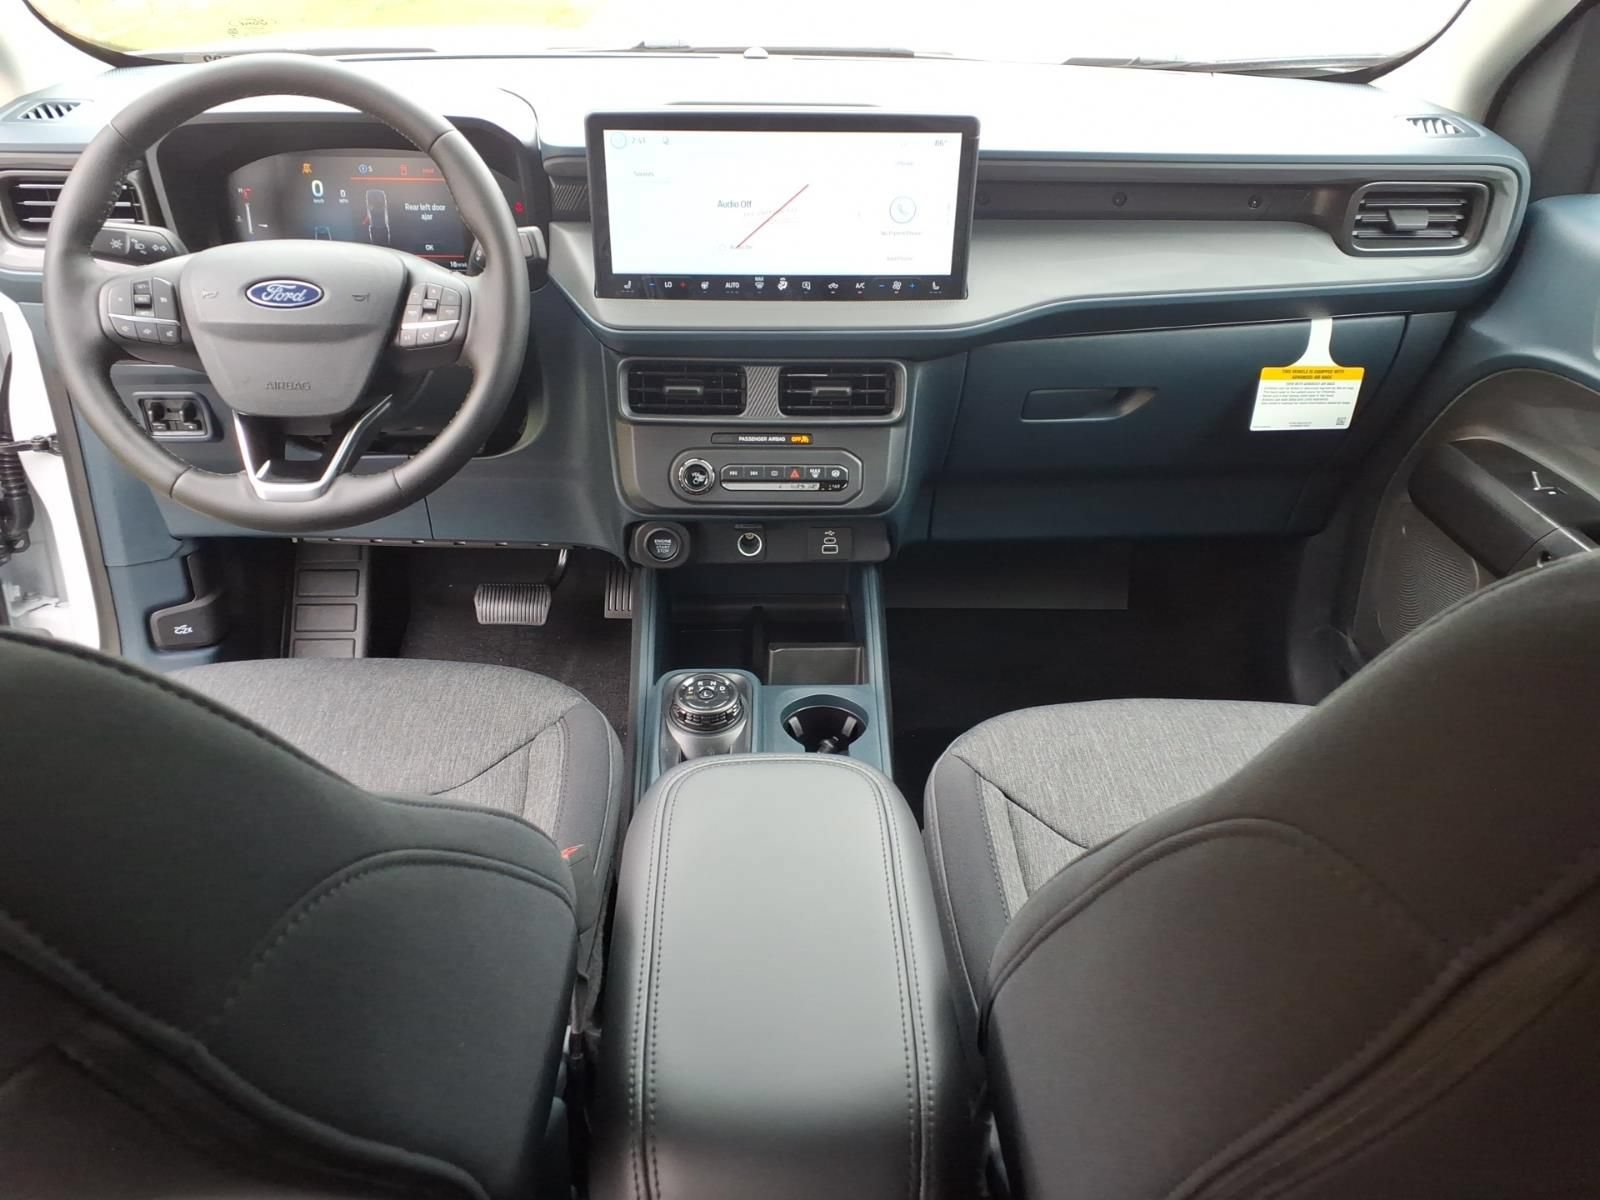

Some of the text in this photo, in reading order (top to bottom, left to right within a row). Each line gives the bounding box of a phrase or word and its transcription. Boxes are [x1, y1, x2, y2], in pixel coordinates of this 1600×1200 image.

[311, 179, 324, 198] 0
[405, 203, 446, 211] Rear left door
[717, 200, 752, 208] Audio Off
[421, 213, 433, 221] ajar
[261, 283, 306, 302] Ford
[266, 381, 311, 391] AIRBAG
